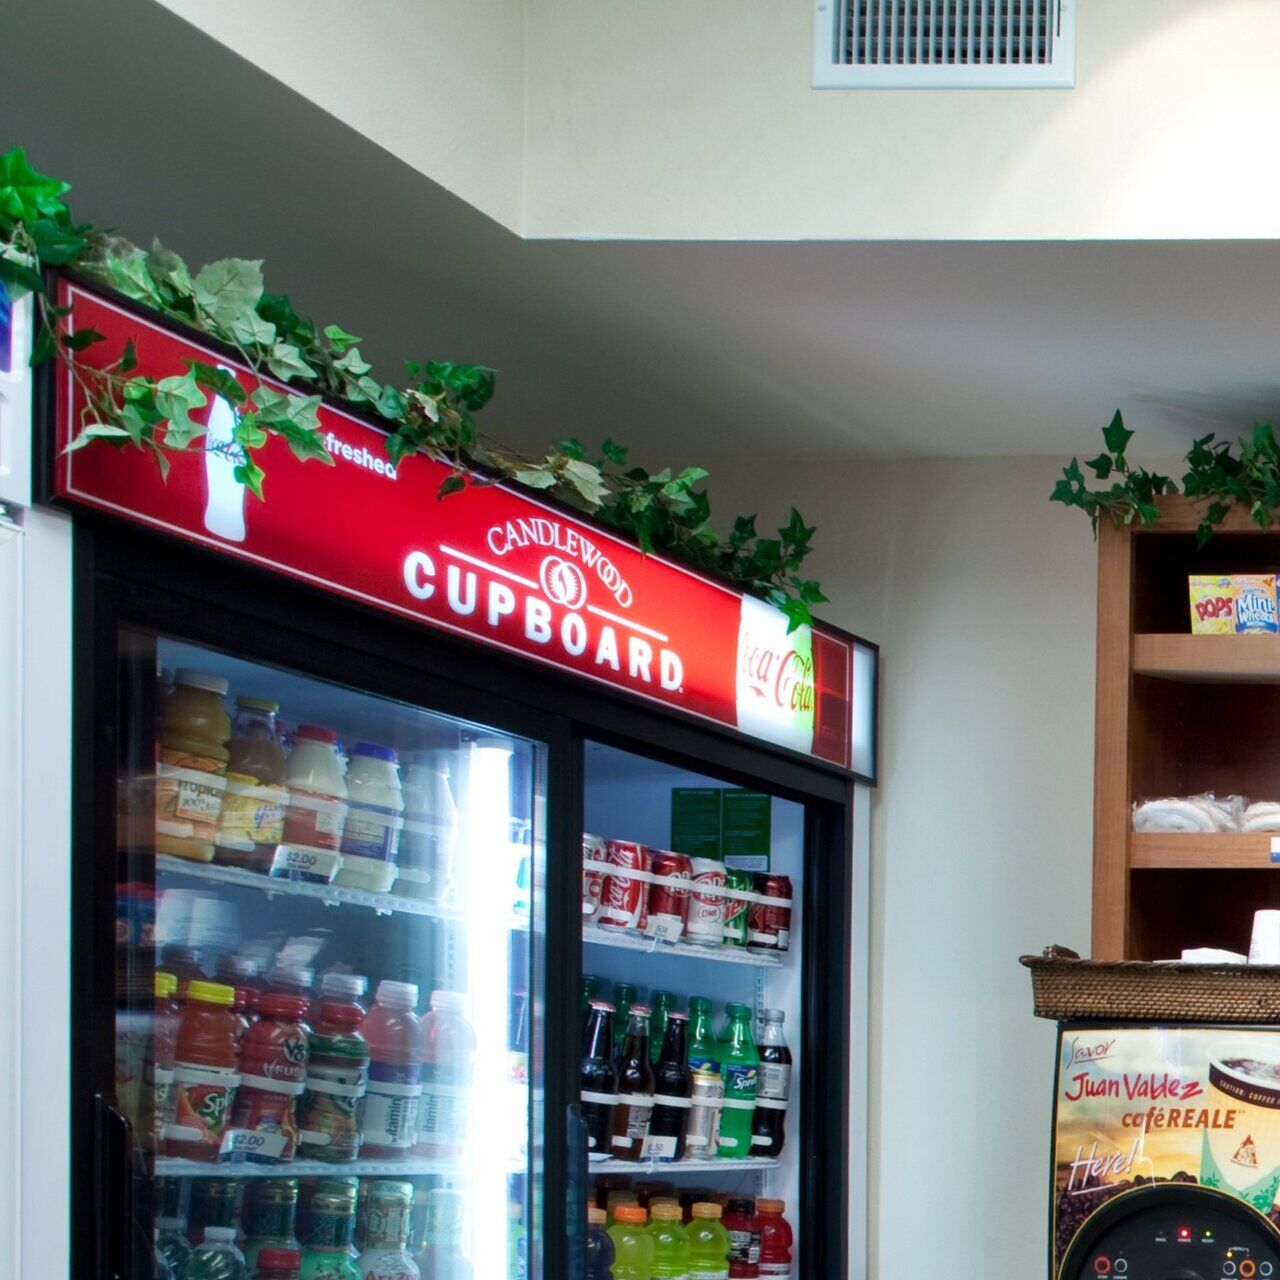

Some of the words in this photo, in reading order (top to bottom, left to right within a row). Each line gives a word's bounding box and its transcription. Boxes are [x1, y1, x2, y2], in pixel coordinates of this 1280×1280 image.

[487, 517, 634, 609] CANDLEWOOD
[403, 551, 684, 693] CUPBOARD
[1195, 597, 1233, 622] POPS
[287, 850, 317, 867] $2.00
[1071, 1038, 1117, 1069] Savor
[1065, 1073, 1121, 1101] Juan
[1122, 1072, 1203, 1099] Valdez
[1248, 1090, 1274, 1106] COFFEE
[233, 1134, 265, 1147] $2.00
[1070, 1136, 1142, 1190] Here!
